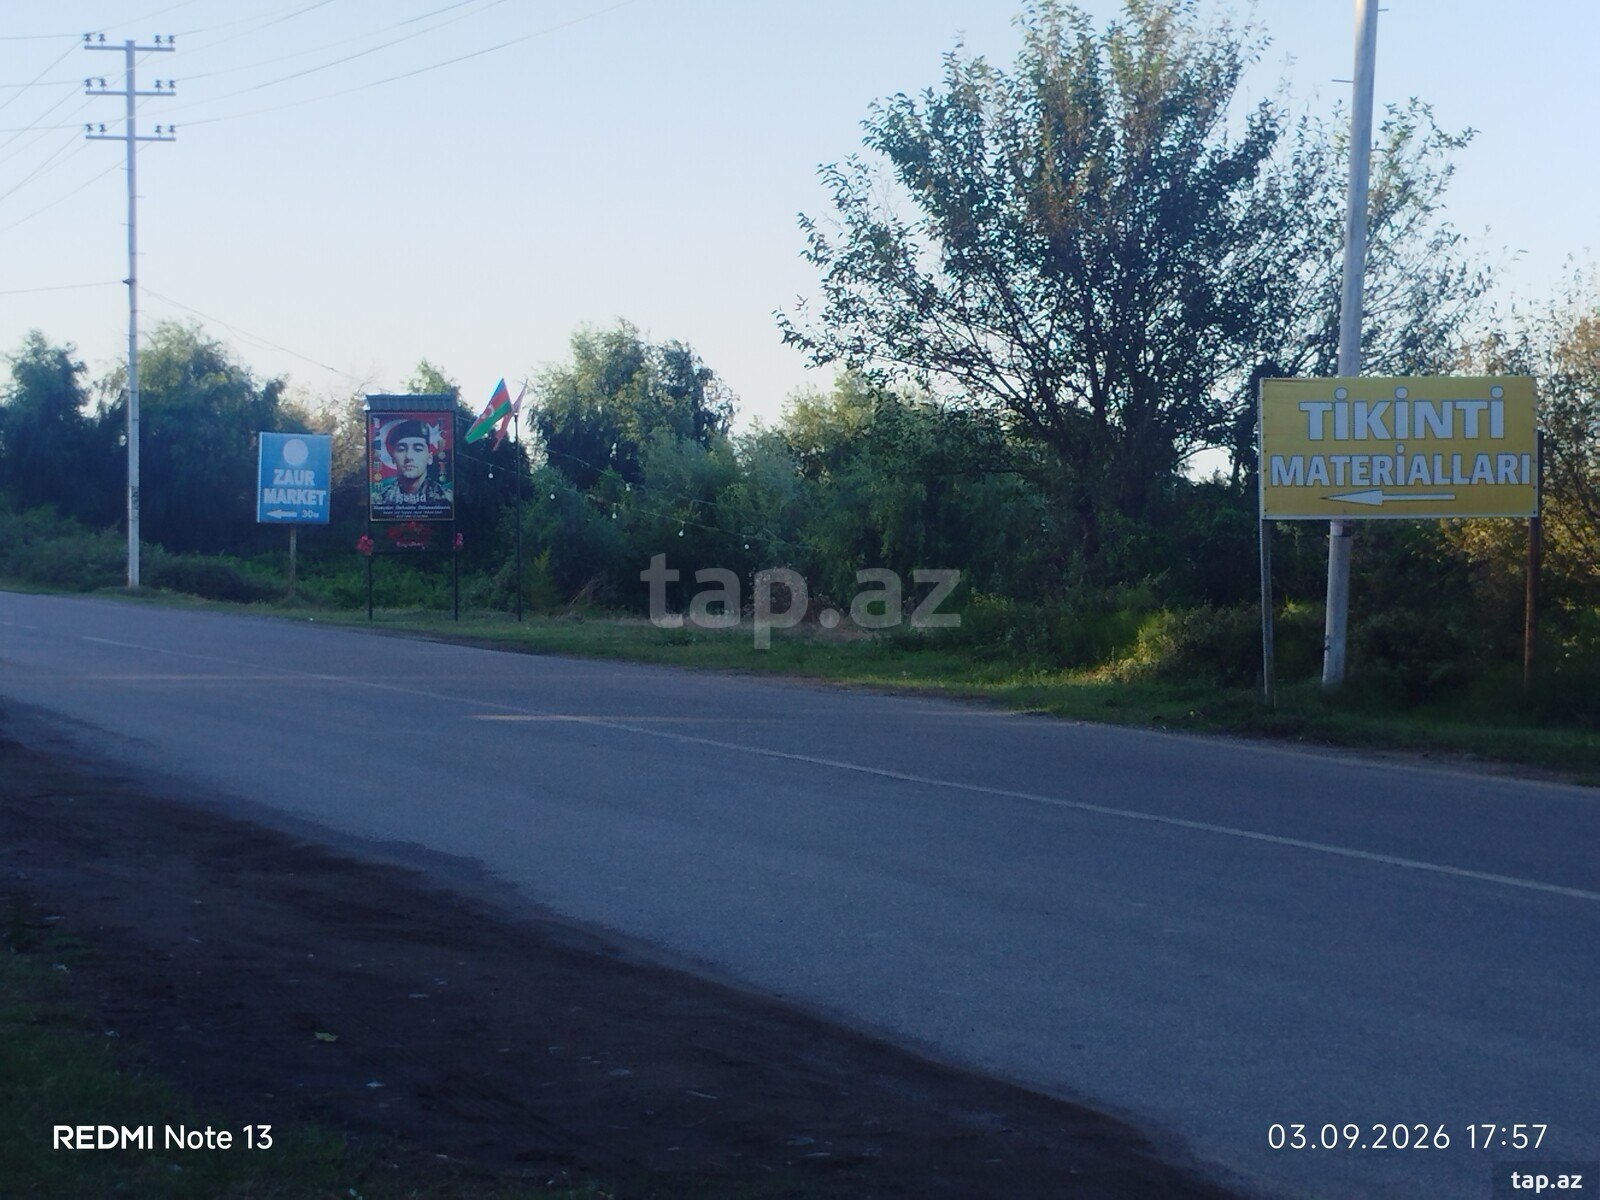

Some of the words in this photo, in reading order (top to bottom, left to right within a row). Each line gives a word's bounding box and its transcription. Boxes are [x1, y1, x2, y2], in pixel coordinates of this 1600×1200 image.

[1299, 385, 1504, 441] TİKİNTİ
[273, 468, 315, 486] ZAUR
[1270, 443, 1531, 487] MATERİALLARI
[263, 488, 326, 506] MARKET
